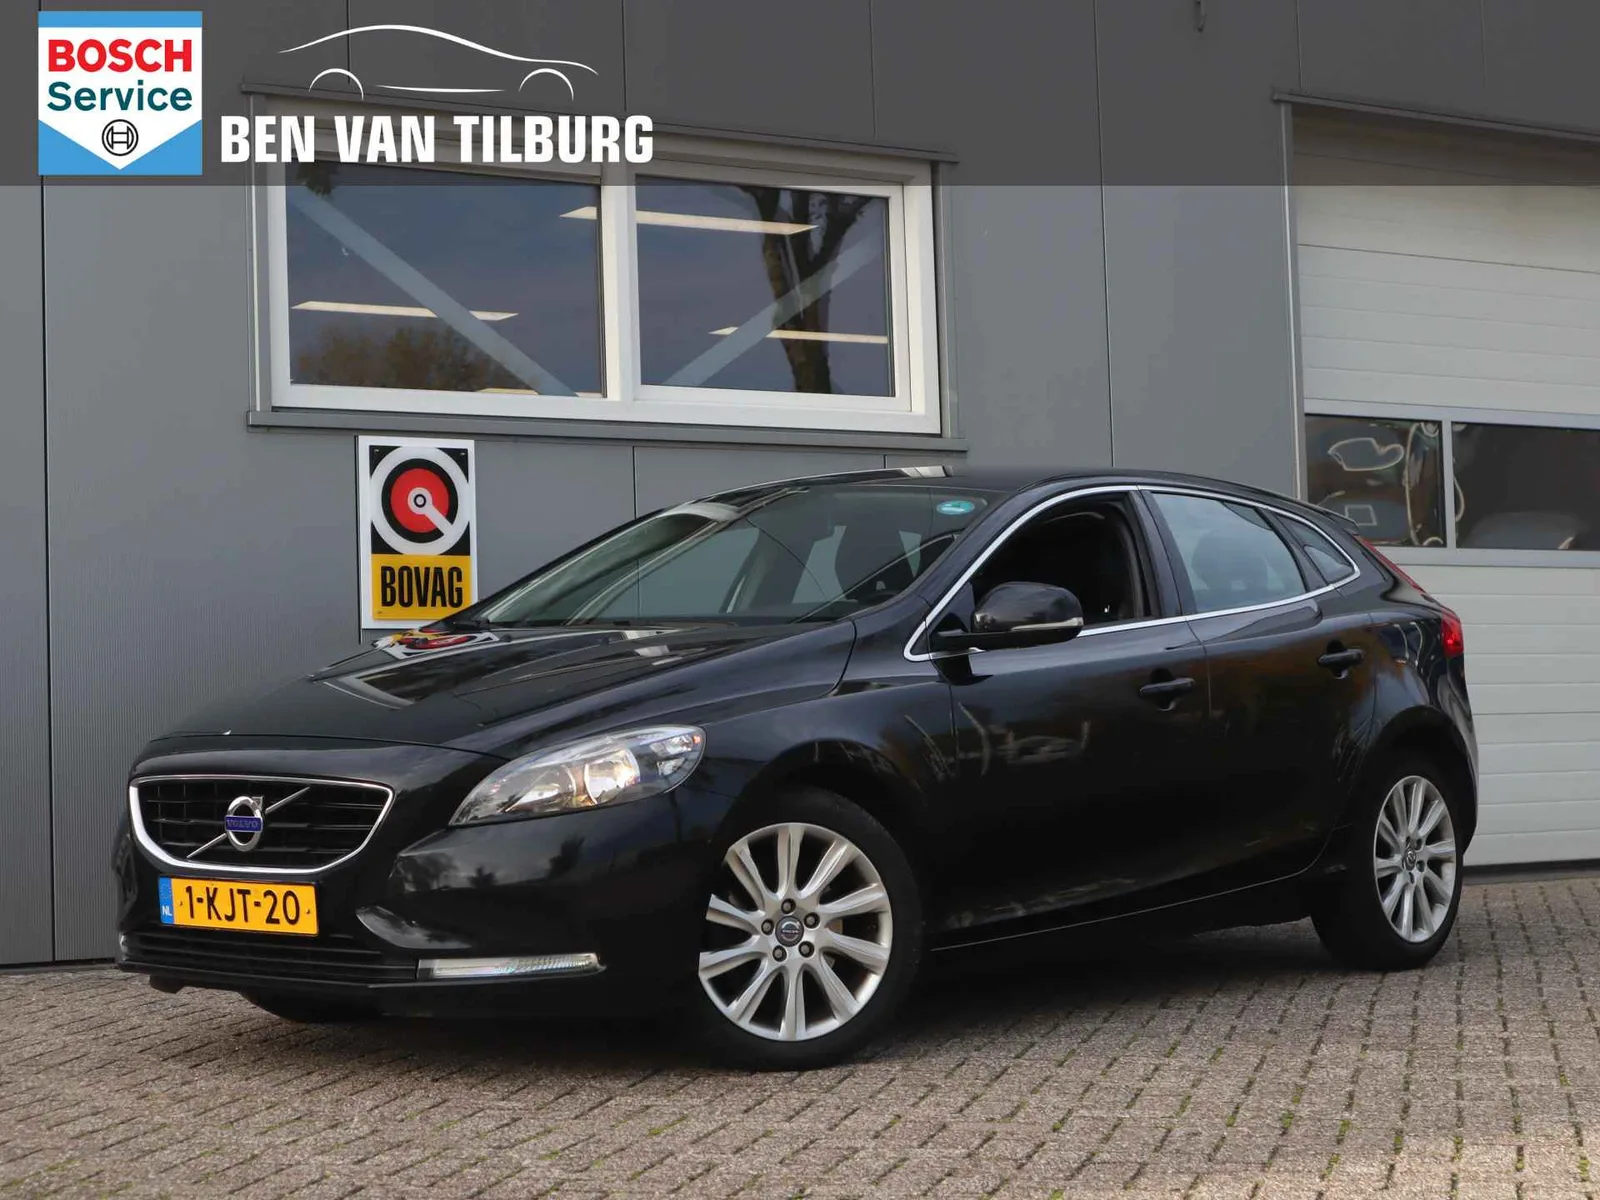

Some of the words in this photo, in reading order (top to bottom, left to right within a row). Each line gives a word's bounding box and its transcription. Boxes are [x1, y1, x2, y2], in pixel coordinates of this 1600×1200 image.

[380, 565, 463, 608] BOVAG
[226, 819, 259, 830] VOLVO
[162, 905, 173, 916] NL
[185, 885, 300, 925] 1-KJT-20
